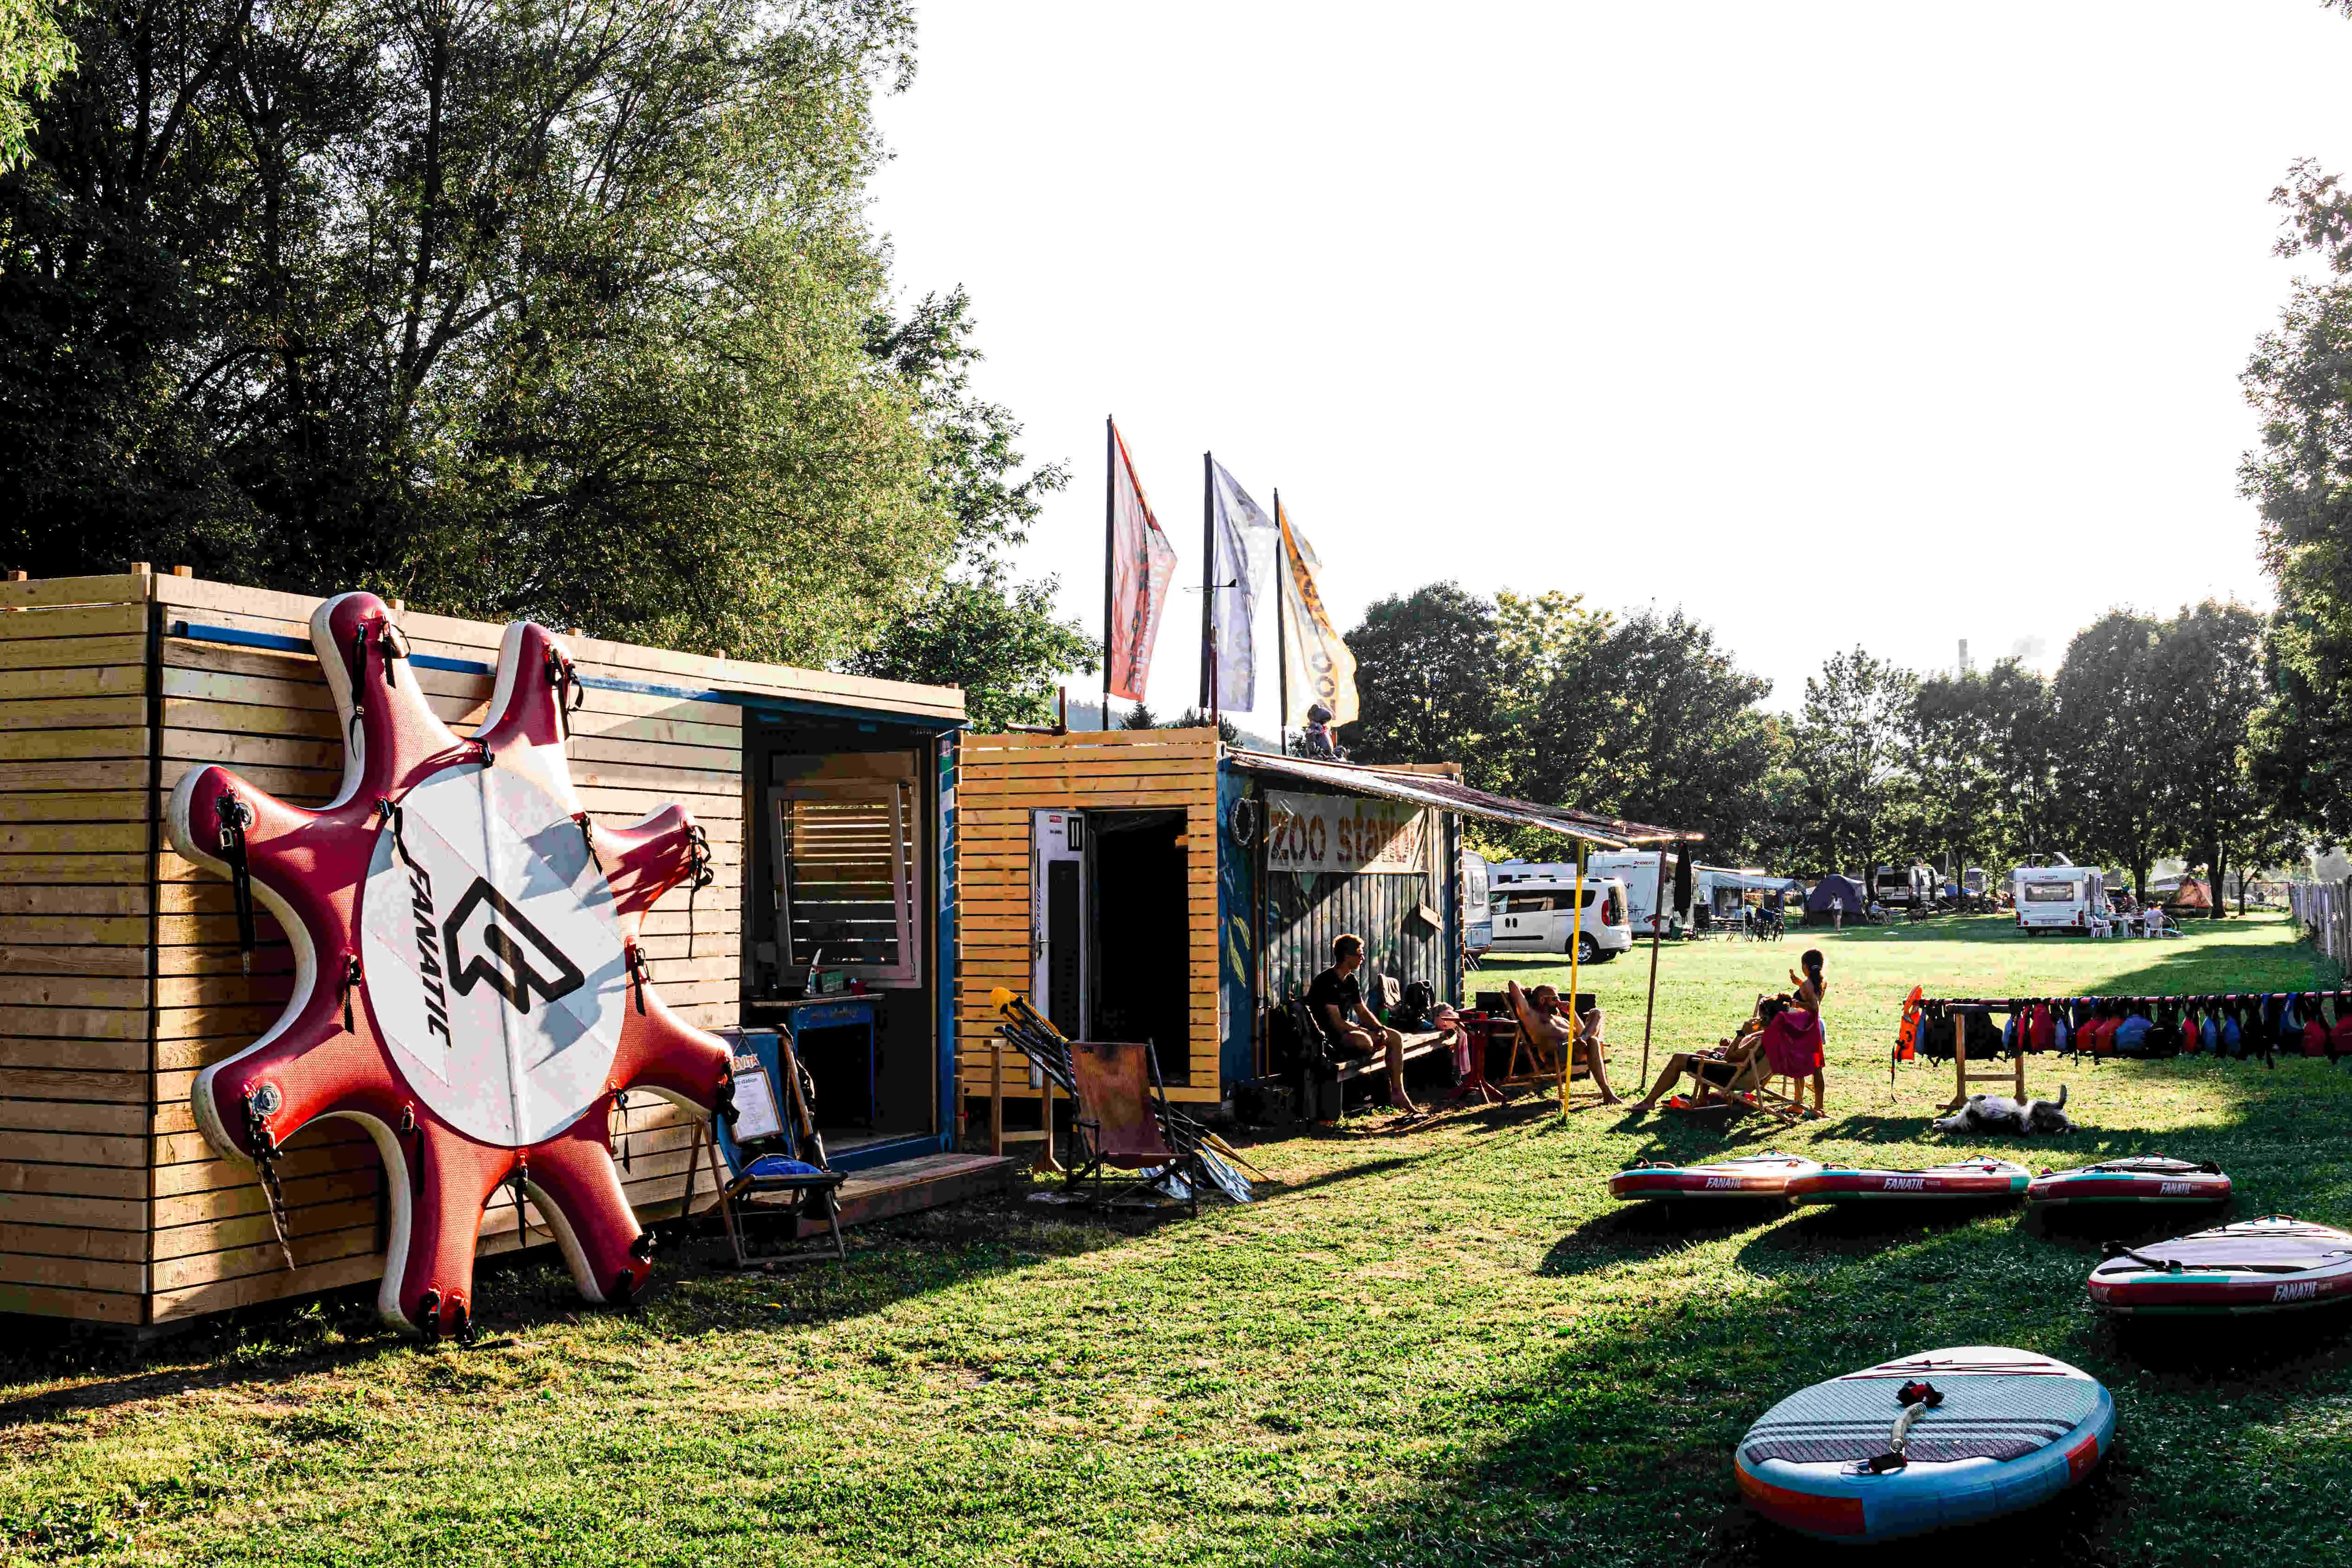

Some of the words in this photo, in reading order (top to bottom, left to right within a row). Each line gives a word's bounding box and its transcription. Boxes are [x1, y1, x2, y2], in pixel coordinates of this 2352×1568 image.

[407, 861, 452, 1048] FANATIC
[1706, 1177, 1741, 1188] FANATIC
[1883, 1178, 1925, 1189] FANATIC
[2160, 1182, 2191, 1195] FANATIC
[2273, 1282, 2317, 1302] FANATIC
